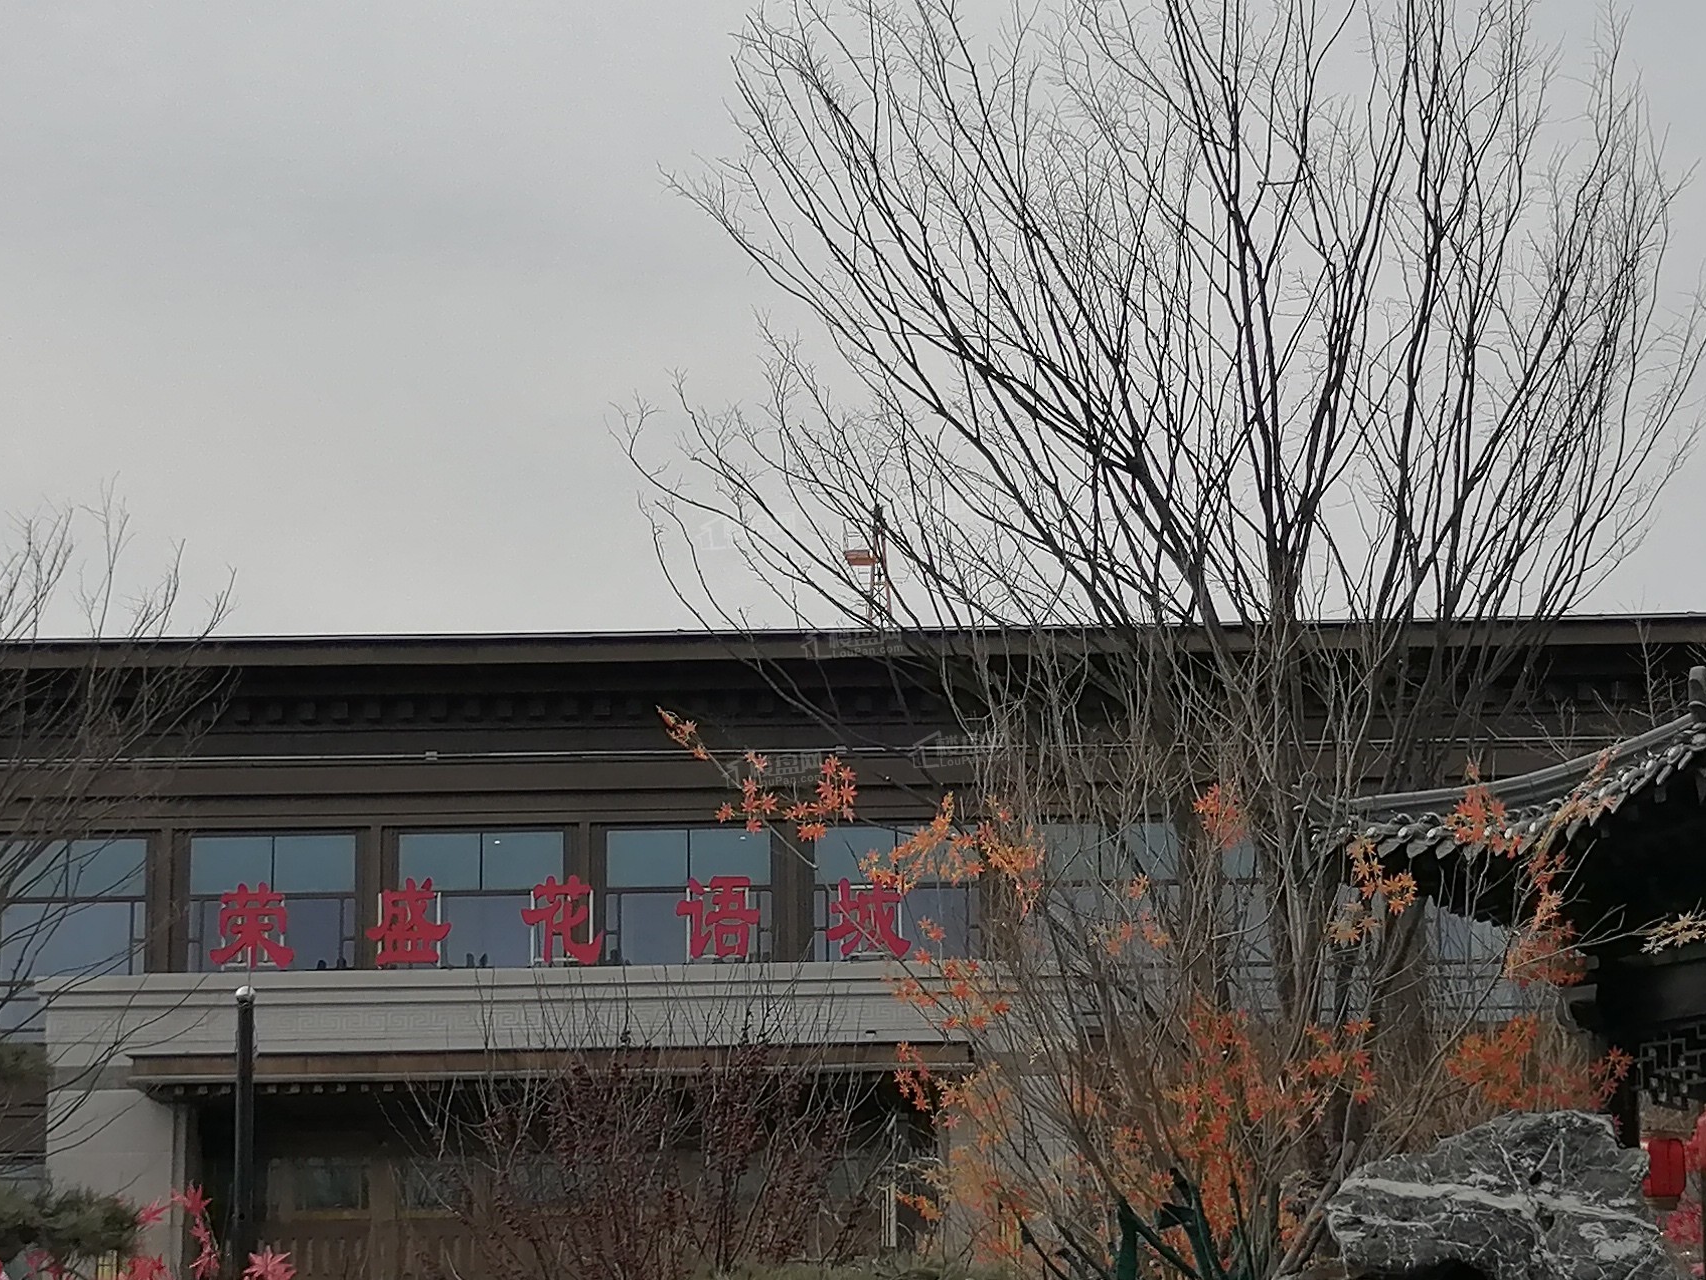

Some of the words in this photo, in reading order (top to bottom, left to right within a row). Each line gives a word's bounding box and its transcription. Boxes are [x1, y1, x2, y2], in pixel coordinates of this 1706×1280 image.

[210, 875, 911, 969] 荣盛花语城
